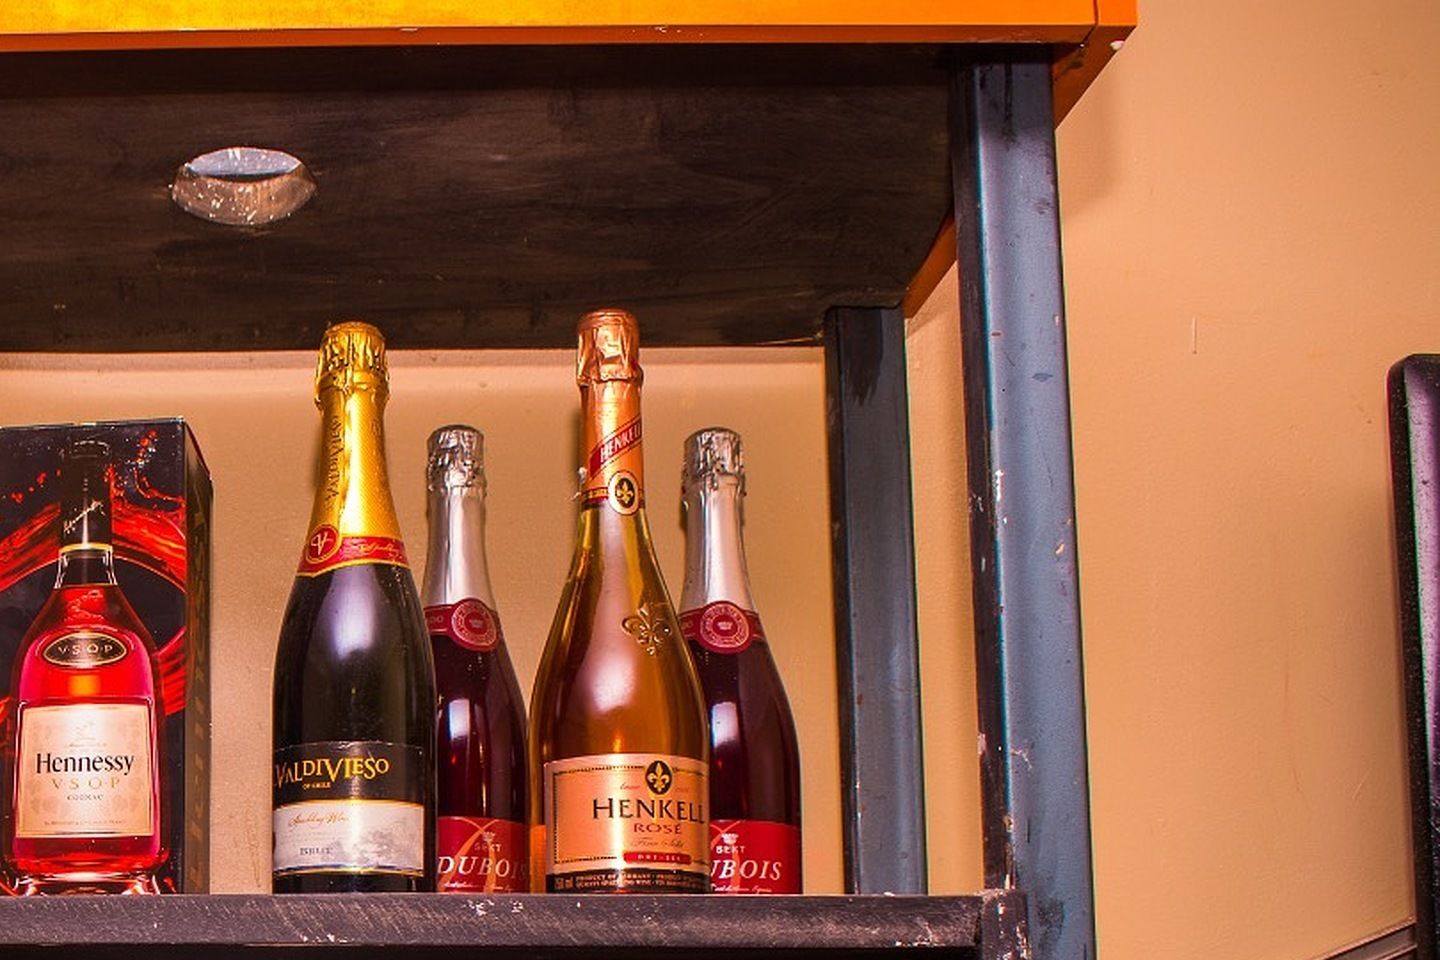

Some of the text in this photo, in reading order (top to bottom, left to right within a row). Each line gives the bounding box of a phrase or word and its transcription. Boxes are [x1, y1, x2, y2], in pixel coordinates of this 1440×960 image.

[36, 753, 135, 776] Hennessy
[276, 757, 390, 790] VALDIVIESO
[593, 797, 706, 824] HENKELL
[634, 822, 682, 835] ROSÉ
